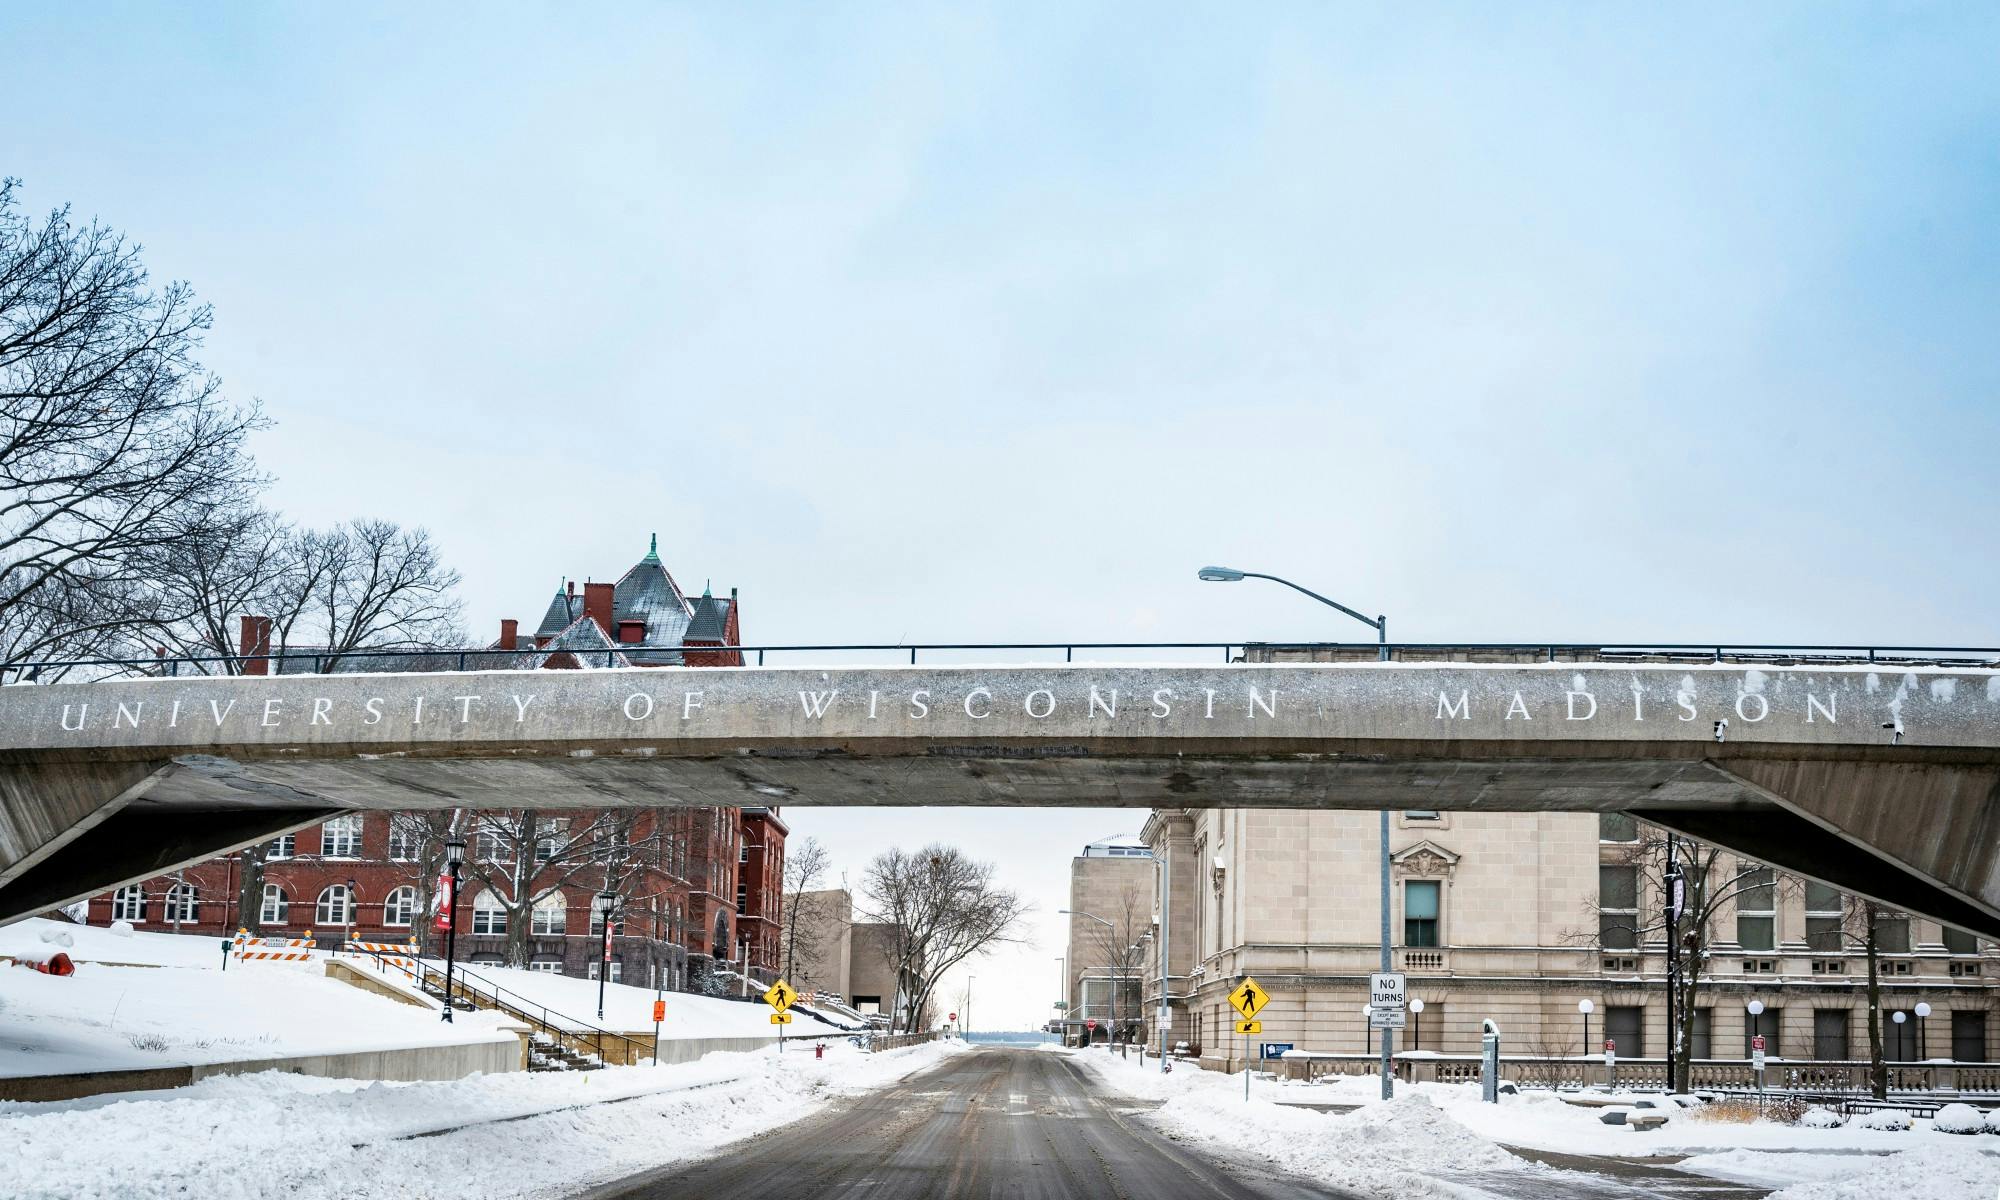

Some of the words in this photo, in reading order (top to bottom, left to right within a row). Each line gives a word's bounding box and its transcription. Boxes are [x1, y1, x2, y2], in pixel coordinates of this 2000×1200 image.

[61, 694, 536, 732] UNIVERSITY
[623, 691, 705, 721] OF
[798, 687, 1280, 720] WISCONSIN
[1434, 689, 1838, 724] MADISON
[1380, 979, 1396, 990] NO
[1372, 993, 1403, 1002] TURNS
